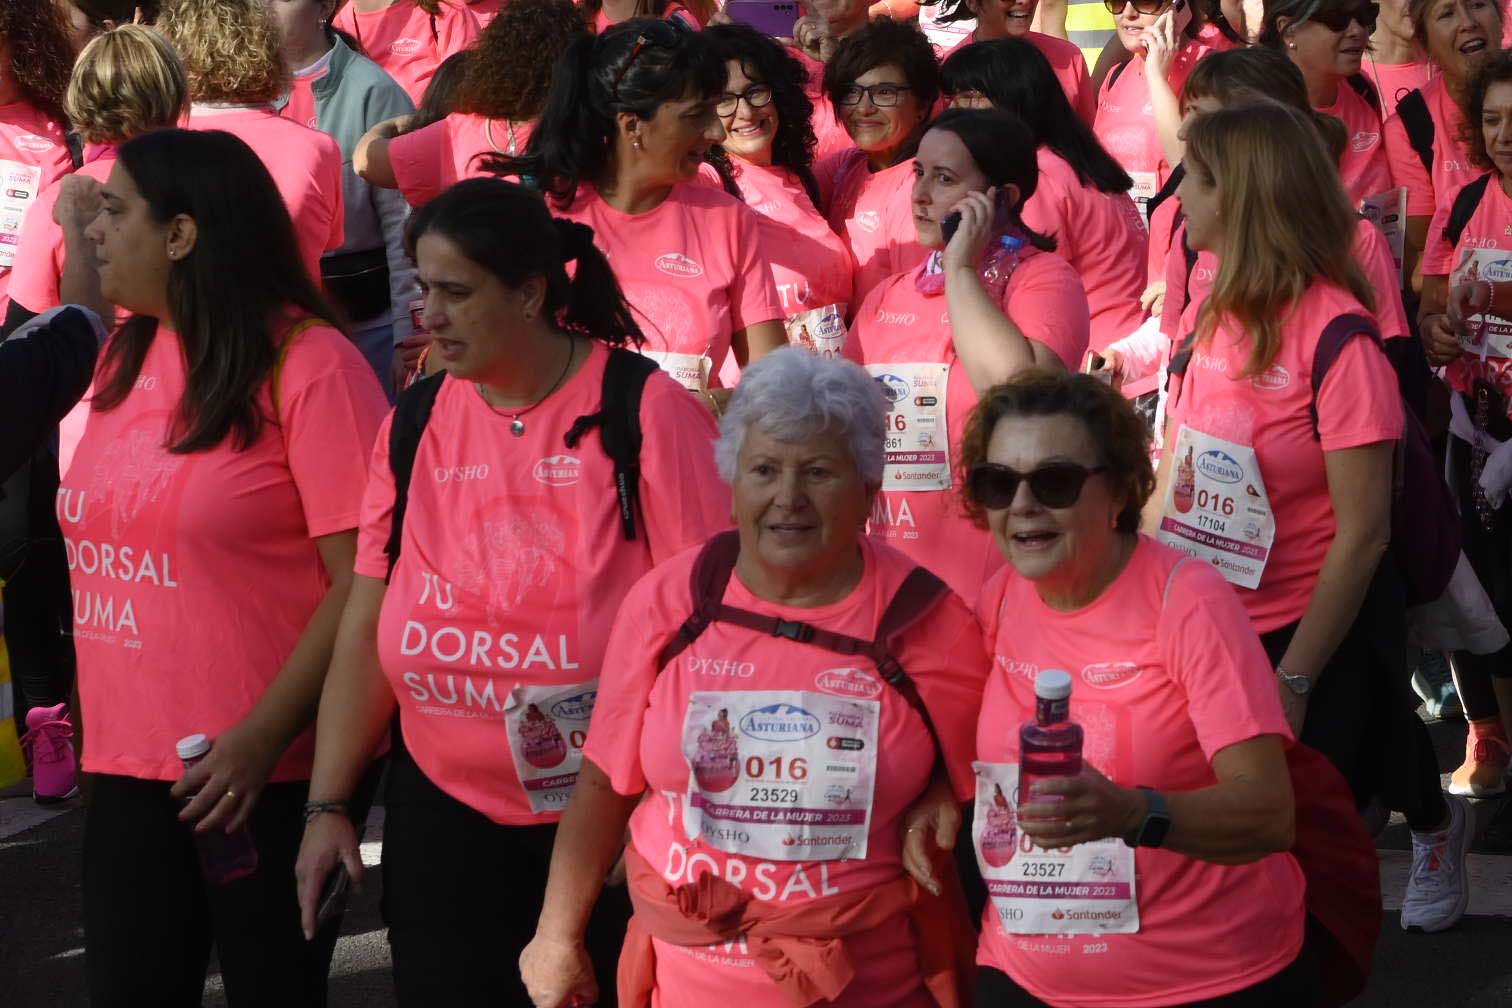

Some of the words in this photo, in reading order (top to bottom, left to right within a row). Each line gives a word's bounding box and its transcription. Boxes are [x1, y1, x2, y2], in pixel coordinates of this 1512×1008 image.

[659, 259, 701, 276] ASTURIANA
[777, 280, 811, 308] TU
[1489, 325, 1499, 334] DE
[1499, 326, 1509, 335] LA
[885, 413, 907, 432] 16
[885, 437, 903, 449] 861
[887, 453, 898, 461] LA
[898, 453, 918, 462] MUJER
[902, 471, 940, 481] Santander
[1200, 457, 1240, 481] ASTURIANA
[1197, 489, 1236, 517] 016
[1198, 514, 1227, 534] 17104
[1197, 532, 1207, 542] DE
[1206, 535, 1215, 545] LA
[1215, 538, 1240, 552] MUJER
[63, 540, 178, 589] DORSAL
[1220, 557, 1257, 577] Santander
[417, 571, 456, 611] TU
[72, 589, 140, 636] UMA
[400, 619, 580, 671] DORSAL
[744, 713, 814, 734] ASTURIANA
[828, 717, 864, 729] SUMA
[744, 755, 809, 781] 016
[749, 787, 798, 804] 23529
[753, 810, 768, 820] DE
[769, 811, 785, 821] LA
[785, 811, 823, 823] MUJER
[827, 813, 851, 823] 2023
[796, 834, 853, 847] Santander
[663, 841, 840, 902] DORSAL
[1021, 862, 1066, 878] 23527
[988, 883, 1024, 894] CARRERA
[1024, 884, 1038, 895] DE
[1039, 885, 1054, 896] LA
[1055, 885, 1089, 897] MUJER
[1092, 886, 1116, 896] 2023
[999, 907, 1024, 921] SHO
[1065, 908, 1122, 921] Santander
[1083, 942, 1108, 954] 2023
